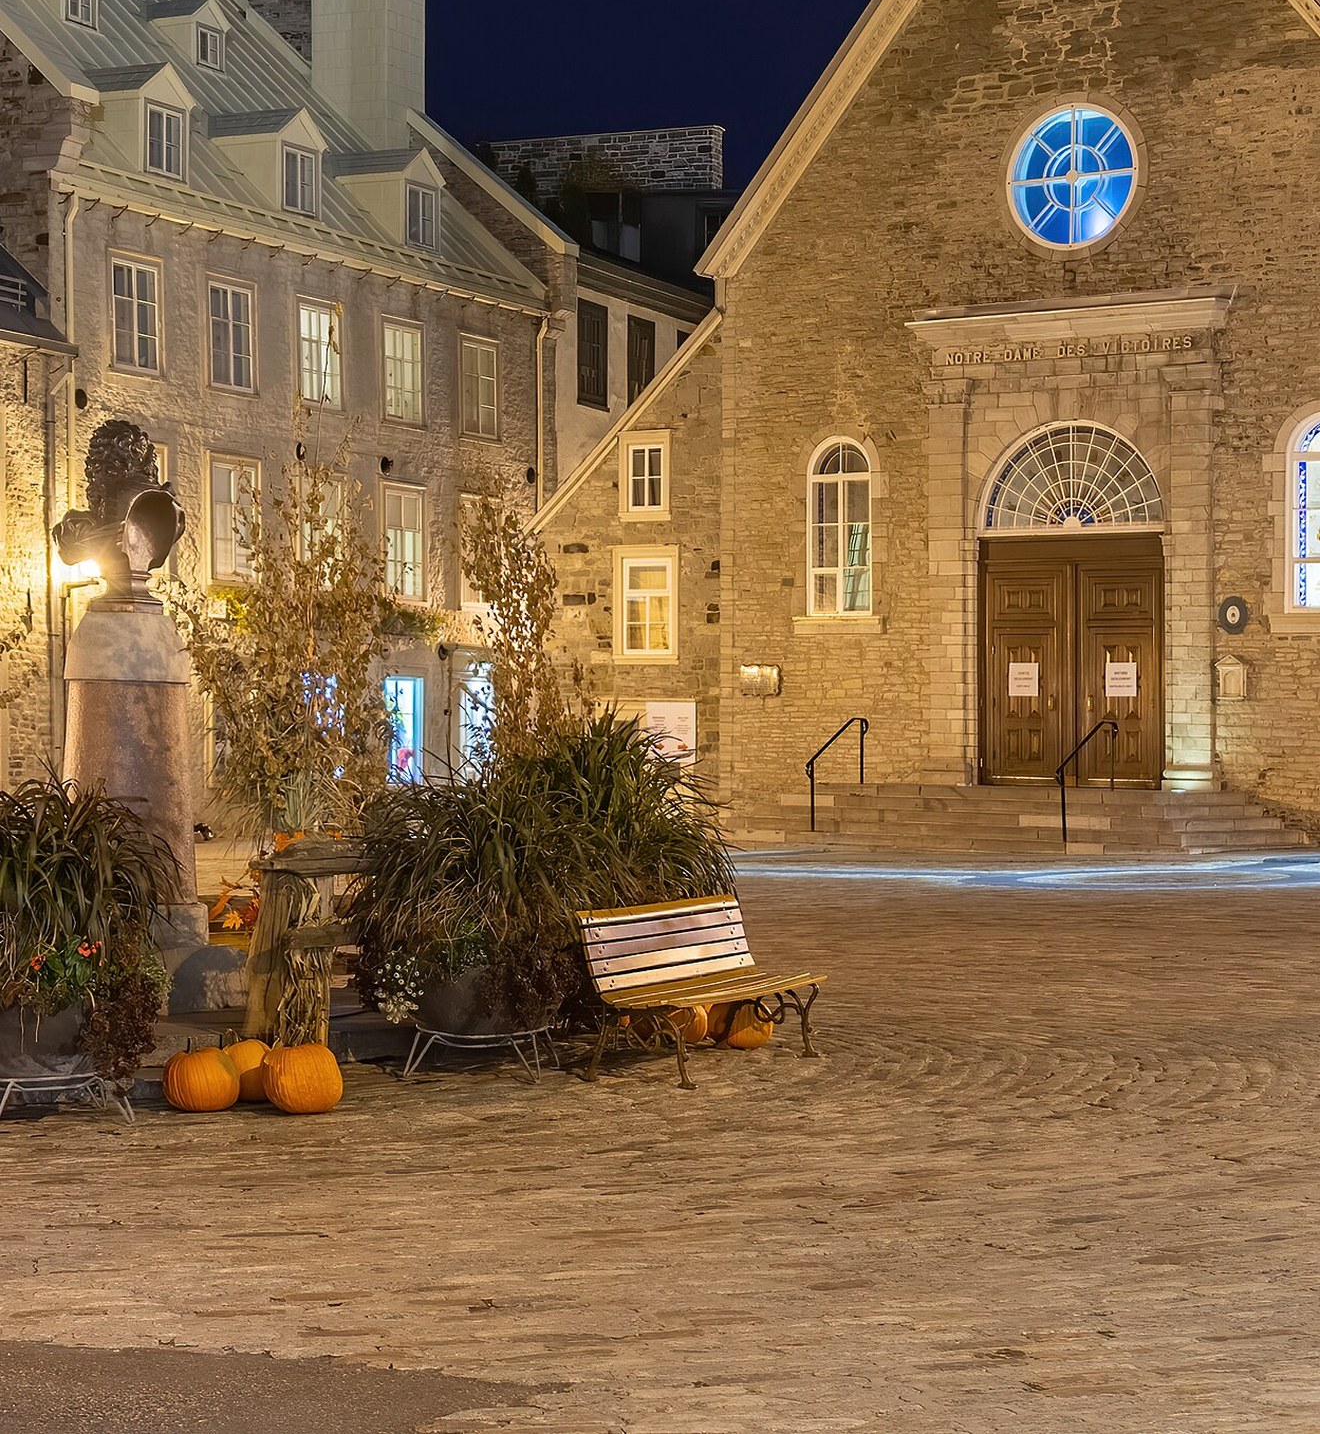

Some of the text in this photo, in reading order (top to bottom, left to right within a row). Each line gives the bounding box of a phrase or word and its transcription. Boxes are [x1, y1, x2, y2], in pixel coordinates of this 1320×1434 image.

[945, 336, 1193, 366] NOTRE DAME DES VICTOIRES
